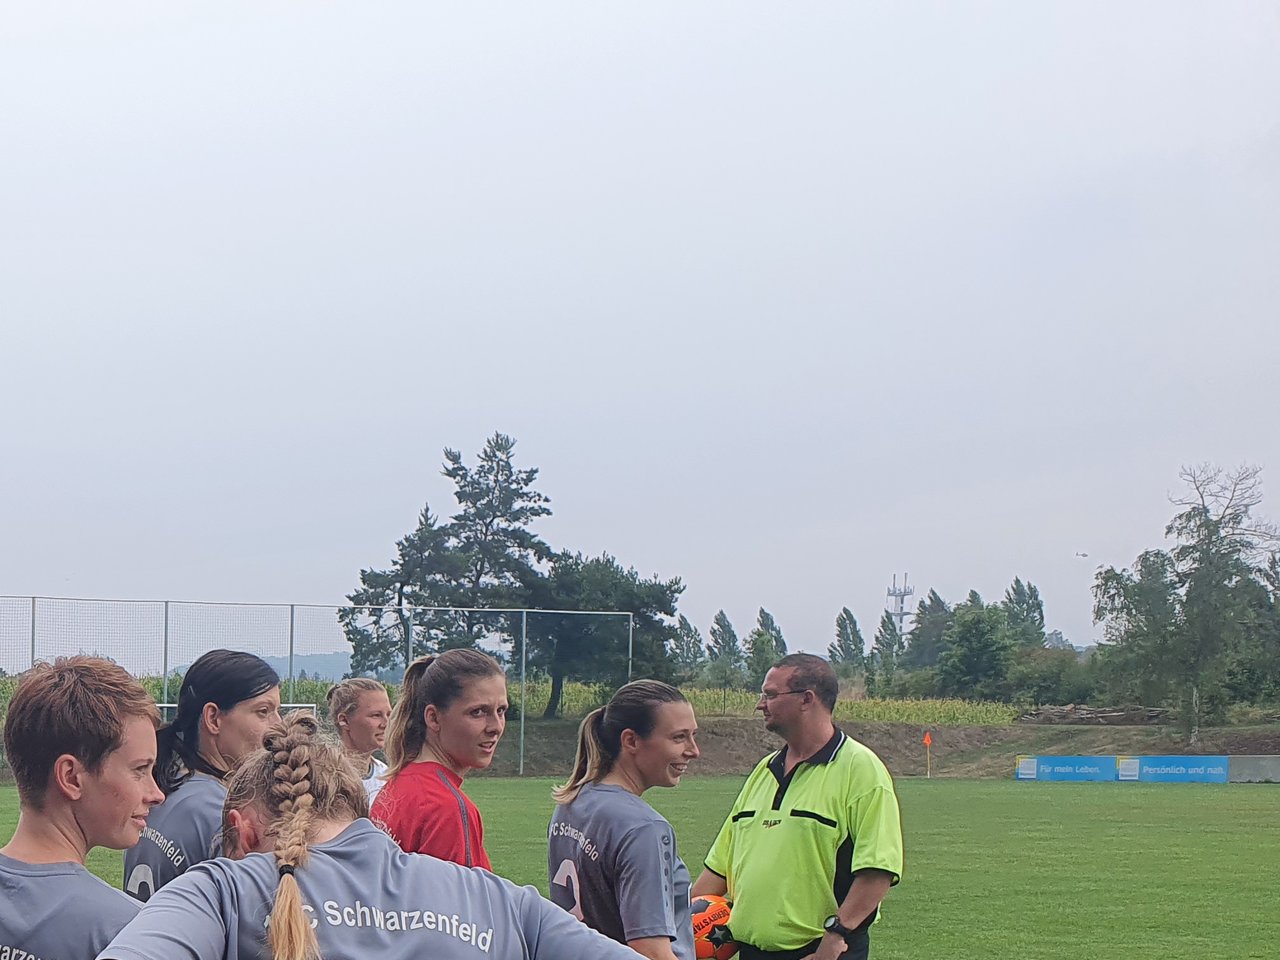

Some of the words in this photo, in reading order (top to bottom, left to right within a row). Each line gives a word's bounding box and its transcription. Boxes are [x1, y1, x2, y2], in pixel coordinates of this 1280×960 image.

[1188, 766, 1204, 774] und
[138, 826, 185, 867] chwarzenfeld
[323, 900, 494, 953] Schwarzenfeld
